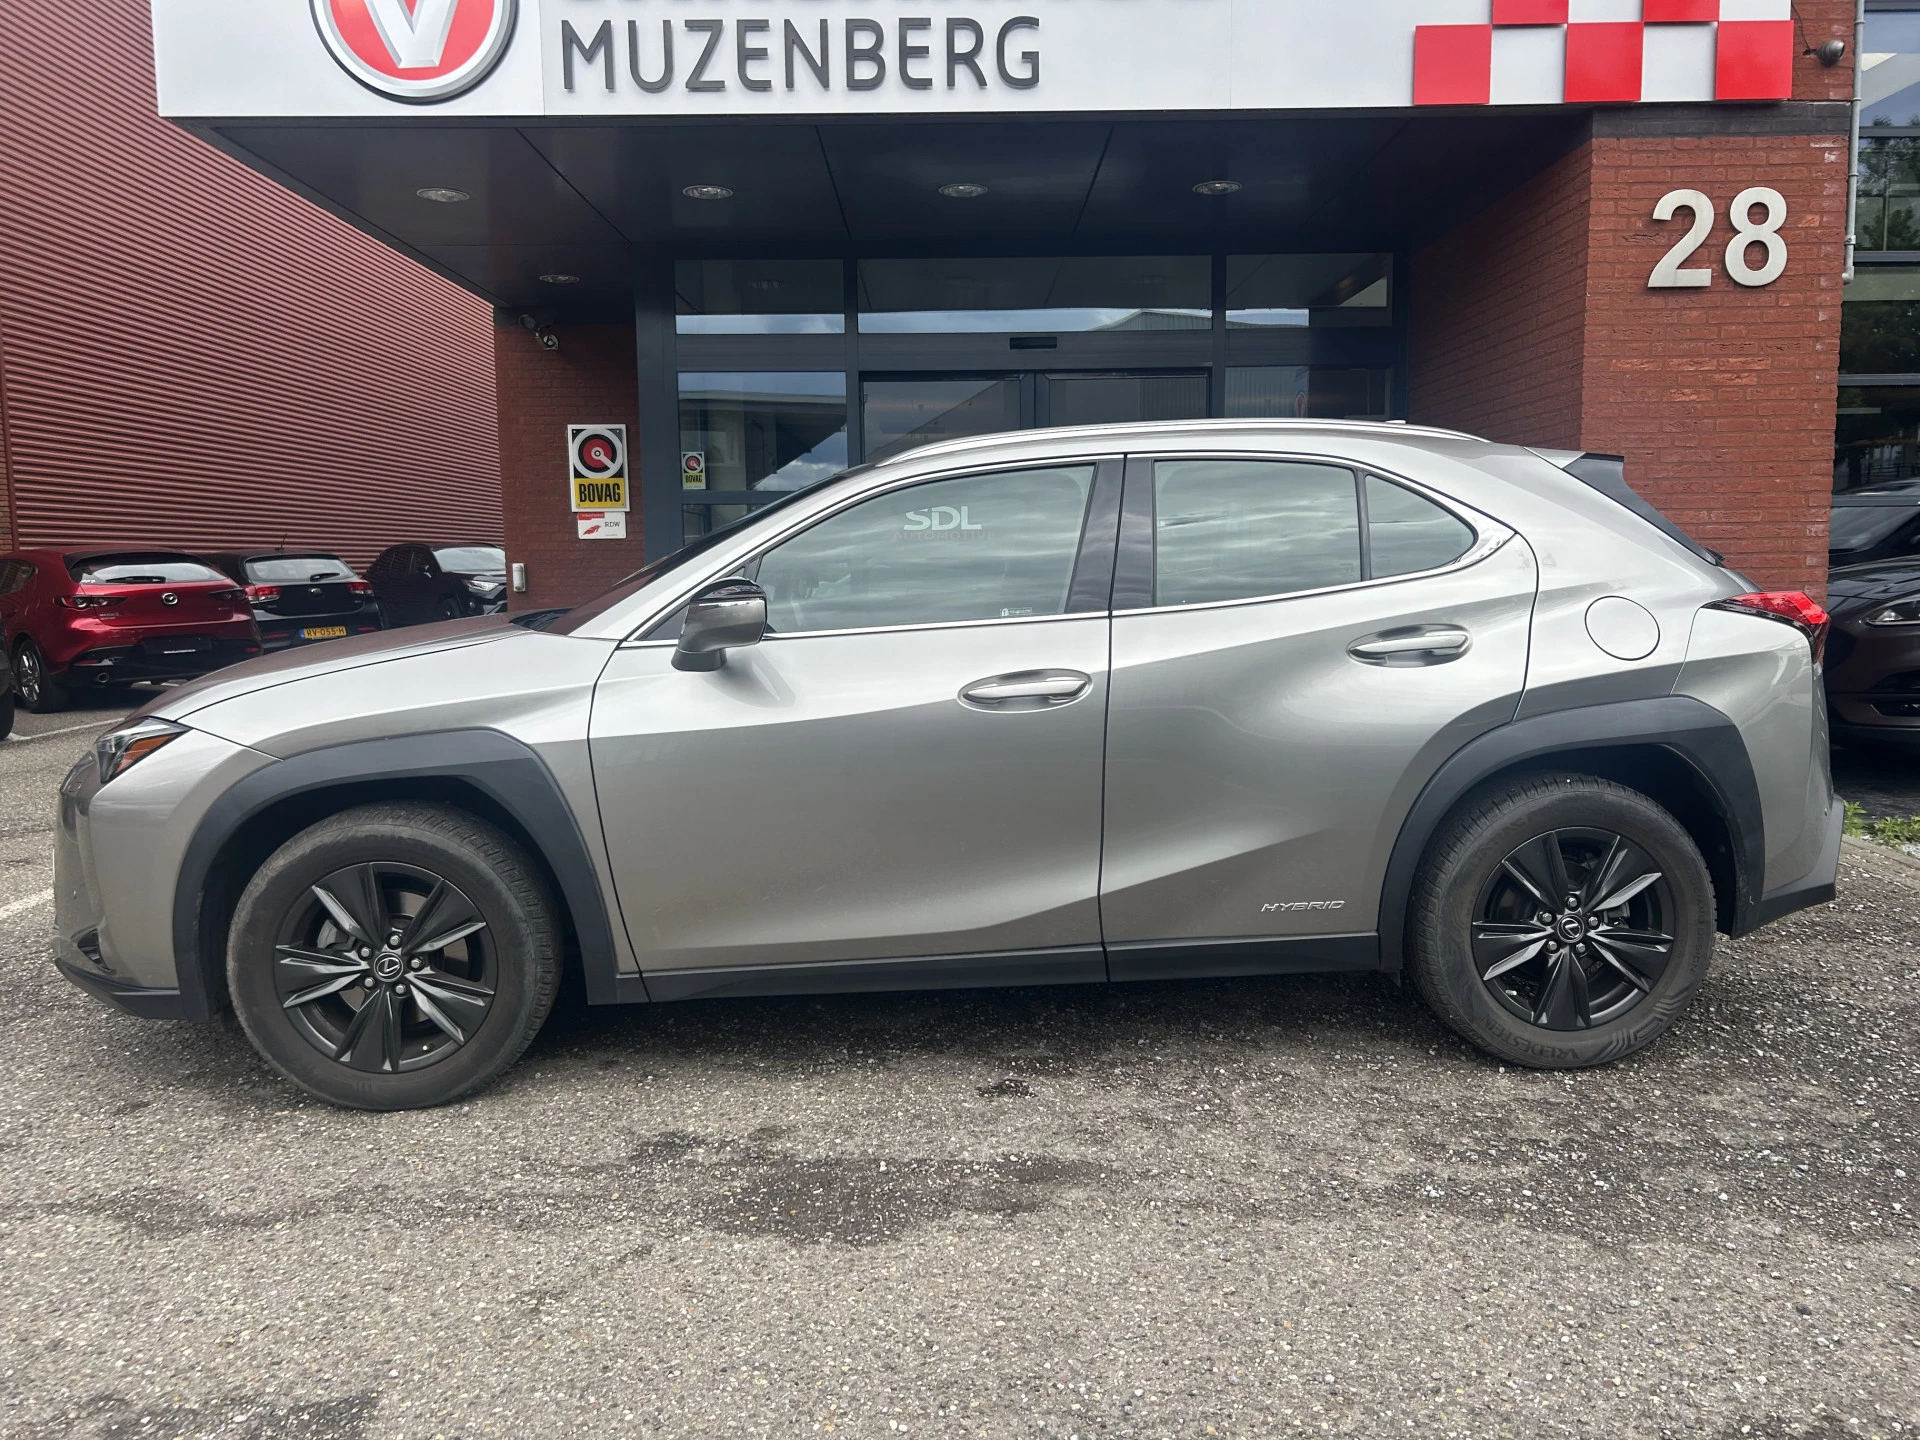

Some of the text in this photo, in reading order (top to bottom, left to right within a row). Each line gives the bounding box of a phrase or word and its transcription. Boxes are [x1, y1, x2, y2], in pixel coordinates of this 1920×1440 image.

[561, 15, 1040, 92] MUZENBERG
[1648, 186, 1788, 288] 28
[685, 474, 703, 484] BOVAG
[579, 483, 621, 503] BOVAG
[903, 505, 983, 531] SDL
[892, 531, 995, 542] AUTOMOTIVE
[306, 627, 345, 637] RV-055-H
[1261, 900, 1346, 912] HYBRID
[1479, 1014, 1581, 1061] VREDESTEIN
